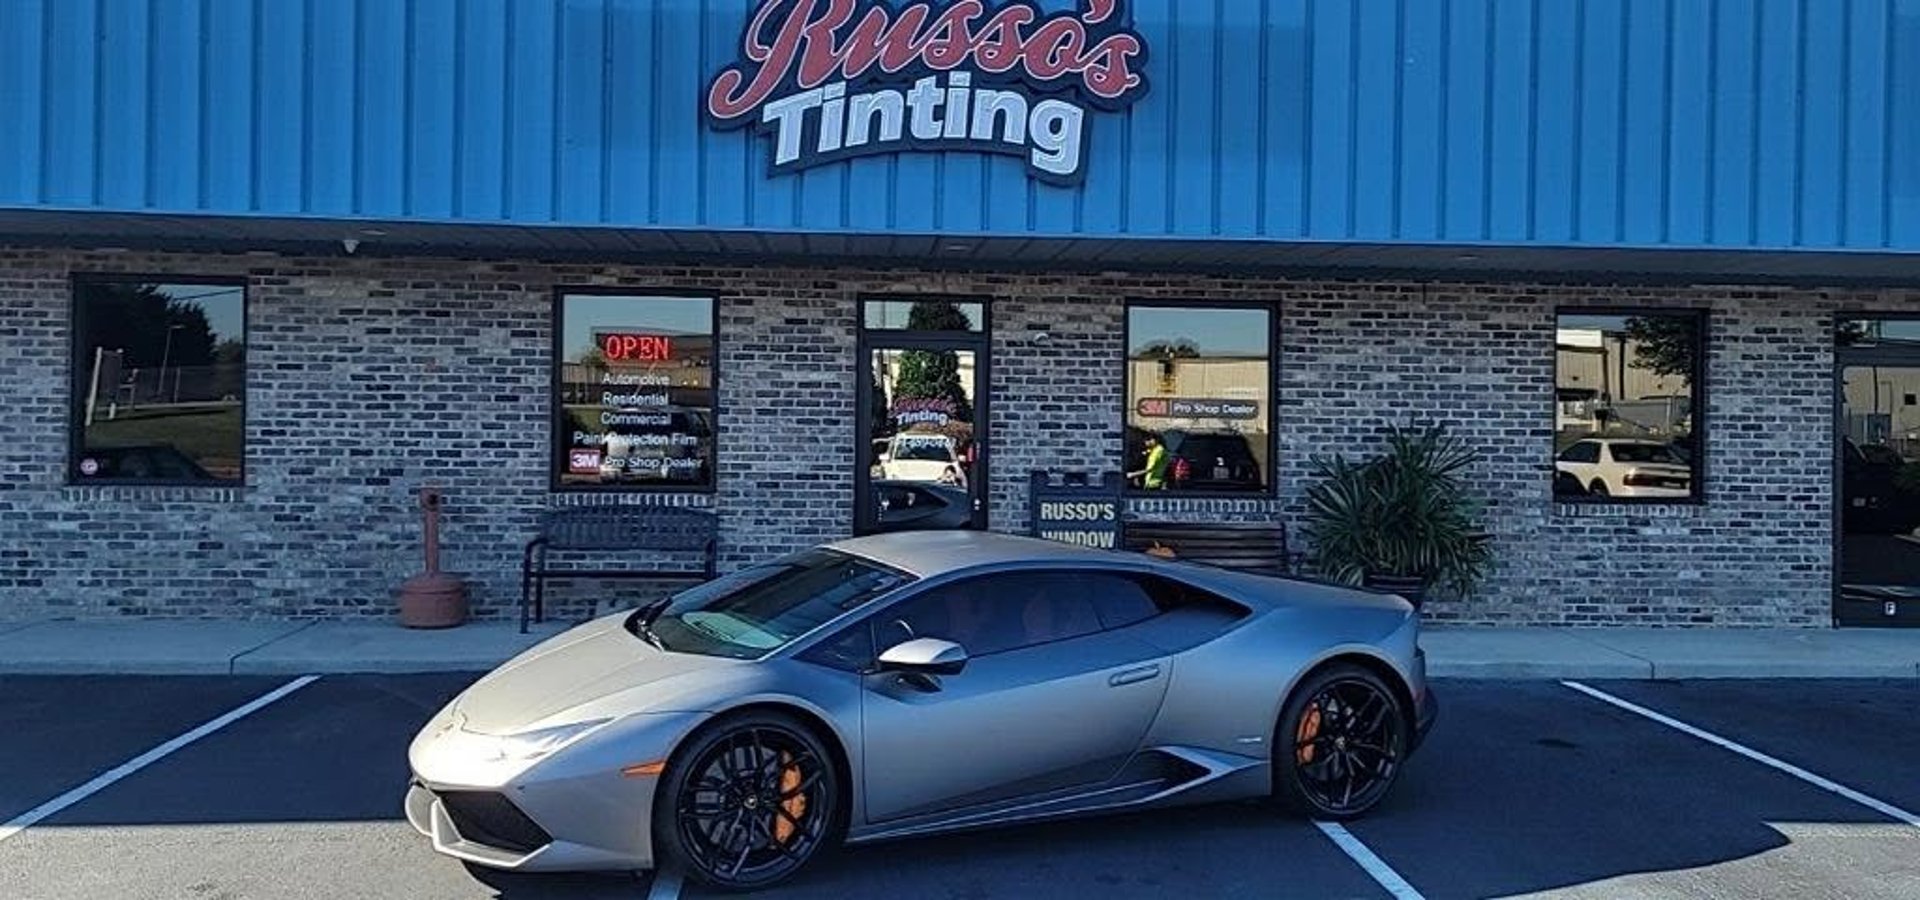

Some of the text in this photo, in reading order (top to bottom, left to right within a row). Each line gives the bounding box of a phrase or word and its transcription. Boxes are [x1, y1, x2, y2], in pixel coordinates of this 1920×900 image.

[709, 0, 1140, 119] Russo's
[762, 71, 1084, 175] Tinting
[606, 335, 669, 360] OPEN
[602, 372, 670, 386] Automotive
[602, 391, 669, 406] Residential
[1140, 400, 1257, 415] 3M Pro Shop Dealer
[601, 411, 672, 425] Commercial
[896, 410, 948, 427] Tinting
[608, 431, 669, 446] Protection
[672, 432, 697, 446] Film
[572, 454, 704, 471] 3M Pro Shop Dealer
[1041, 502, 1115, 520] RUSSO'S
